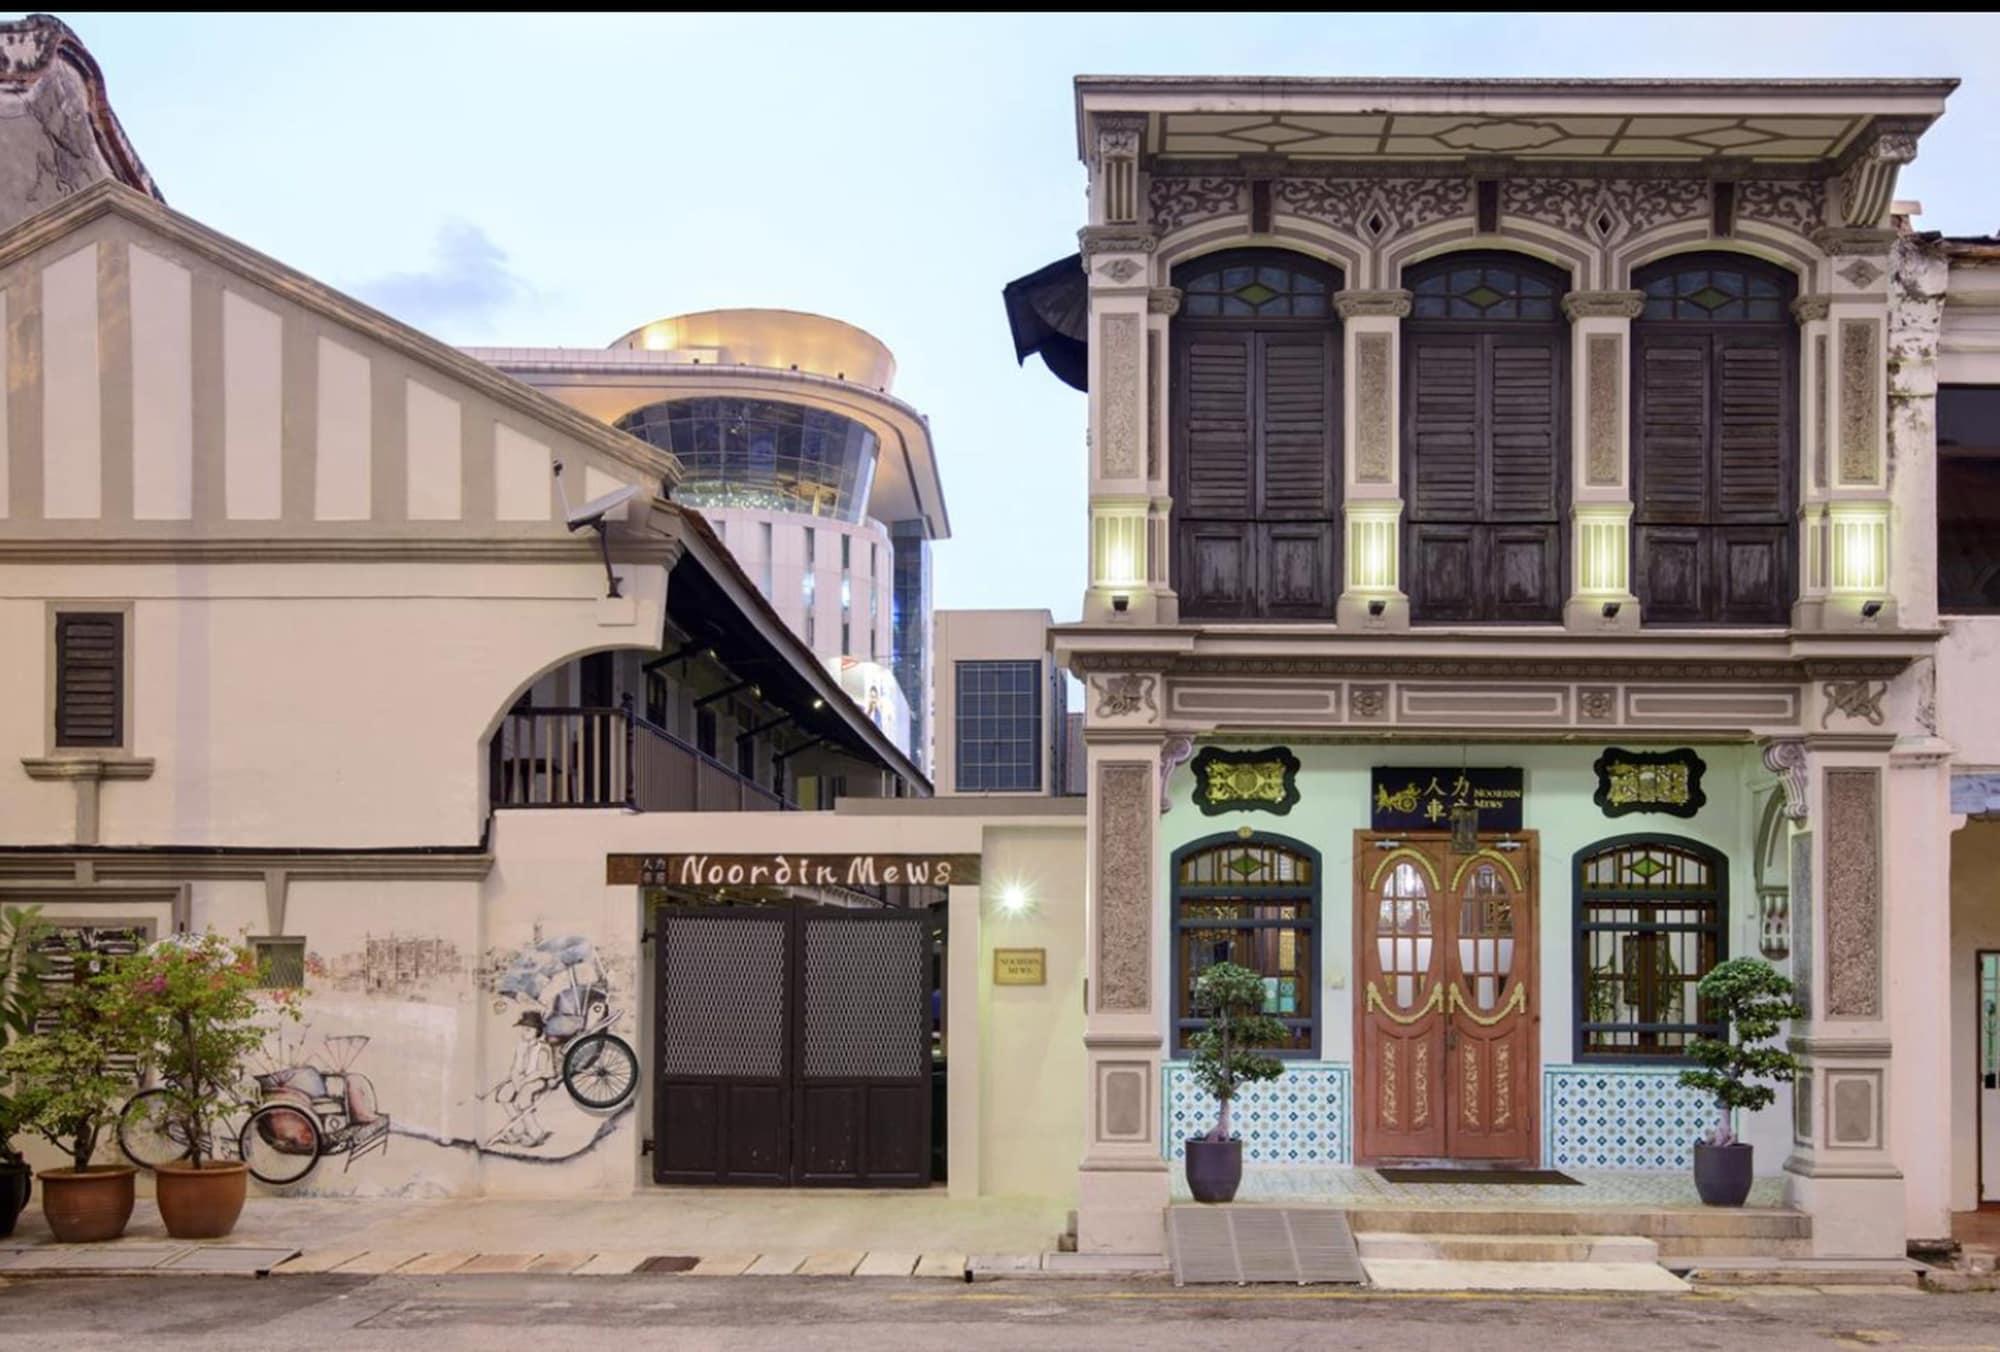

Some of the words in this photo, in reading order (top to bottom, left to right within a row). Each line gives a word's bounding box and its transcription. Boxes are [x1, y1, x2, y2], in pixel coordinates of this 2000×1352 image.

[1424, 776, 1470, 797] 人力
[681, 856, 838, 885] Noordin
[847, 856, 952, 886] Mews
